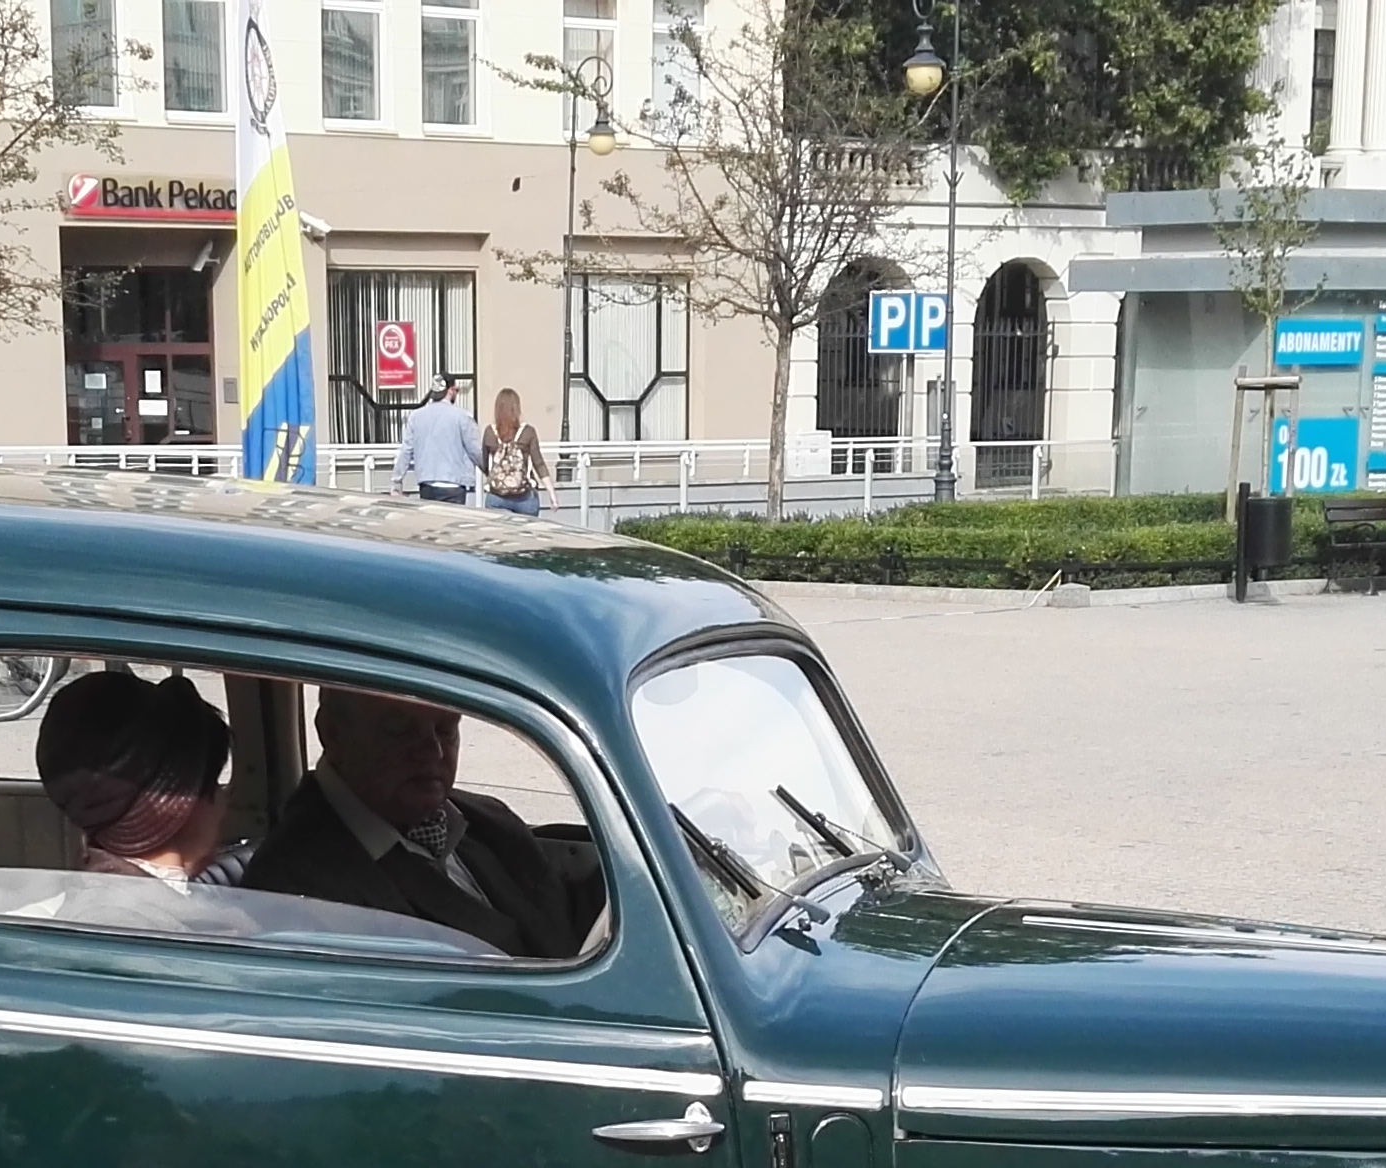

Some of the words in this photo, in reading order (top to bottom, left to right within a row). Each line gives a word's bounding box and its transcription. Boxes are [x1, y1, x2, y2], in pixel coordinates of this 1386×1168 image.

[101, 177, 163, 208] Bank
[879, 296, 906, 347] P
[921, 296, 946, 347] P
[1278, 331, 1362, 353] ABONAMENTY
[1278, 446, 1329, 490] 100
